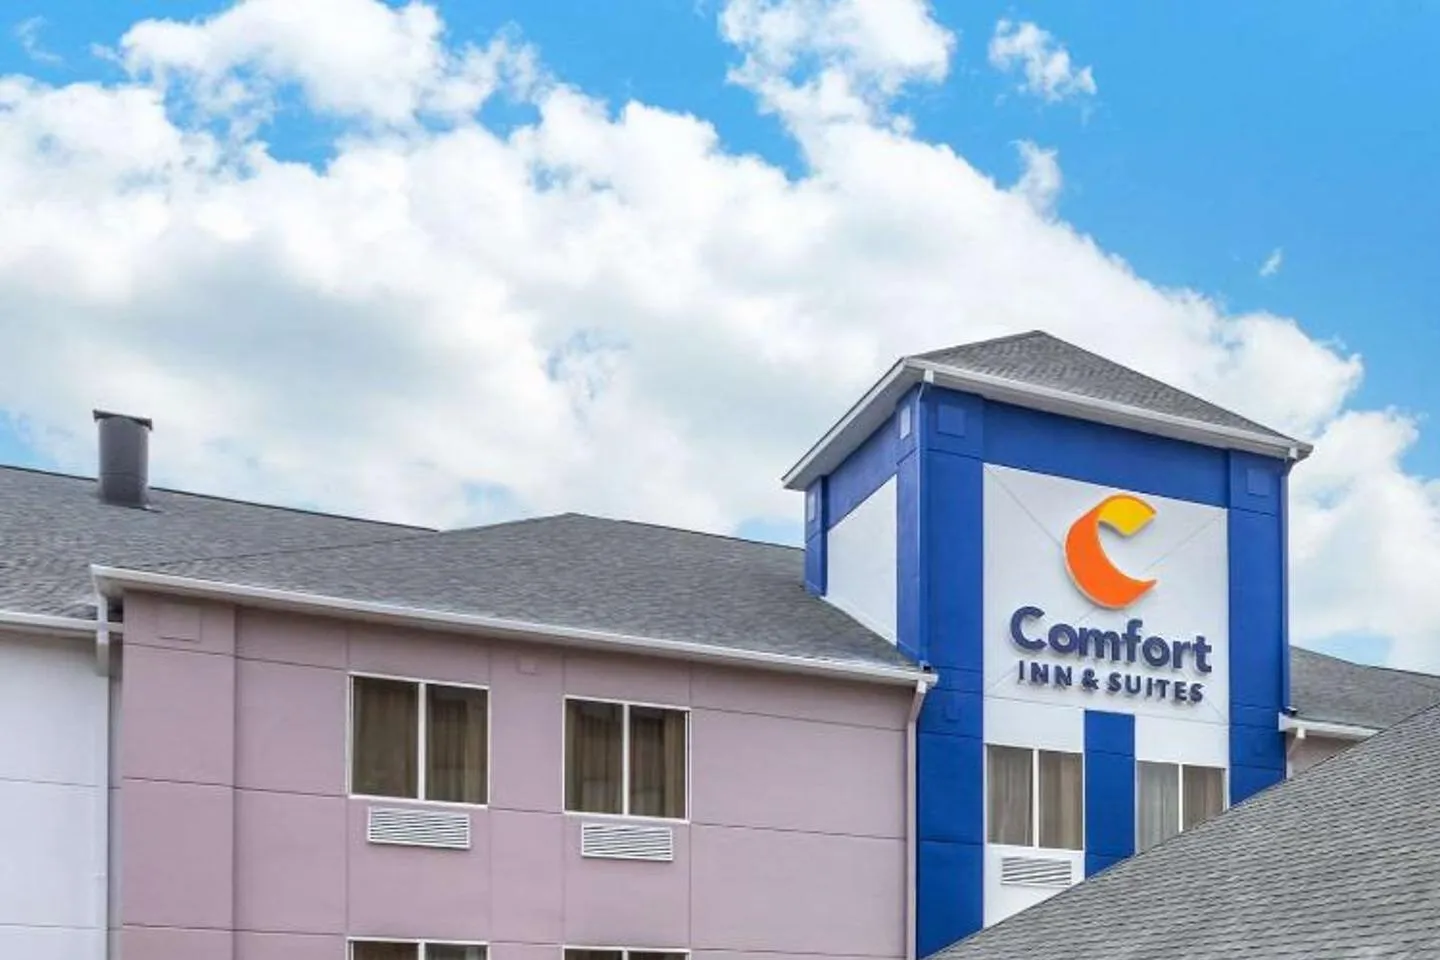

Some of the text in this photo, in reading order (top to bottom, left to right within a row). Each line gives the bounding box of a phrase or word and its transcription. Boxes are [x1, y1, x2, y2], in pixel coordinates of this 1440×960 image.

[1010, 606, 1212, 673] Comfort
[1018, 660, 1204, 702] INN & SUITES
